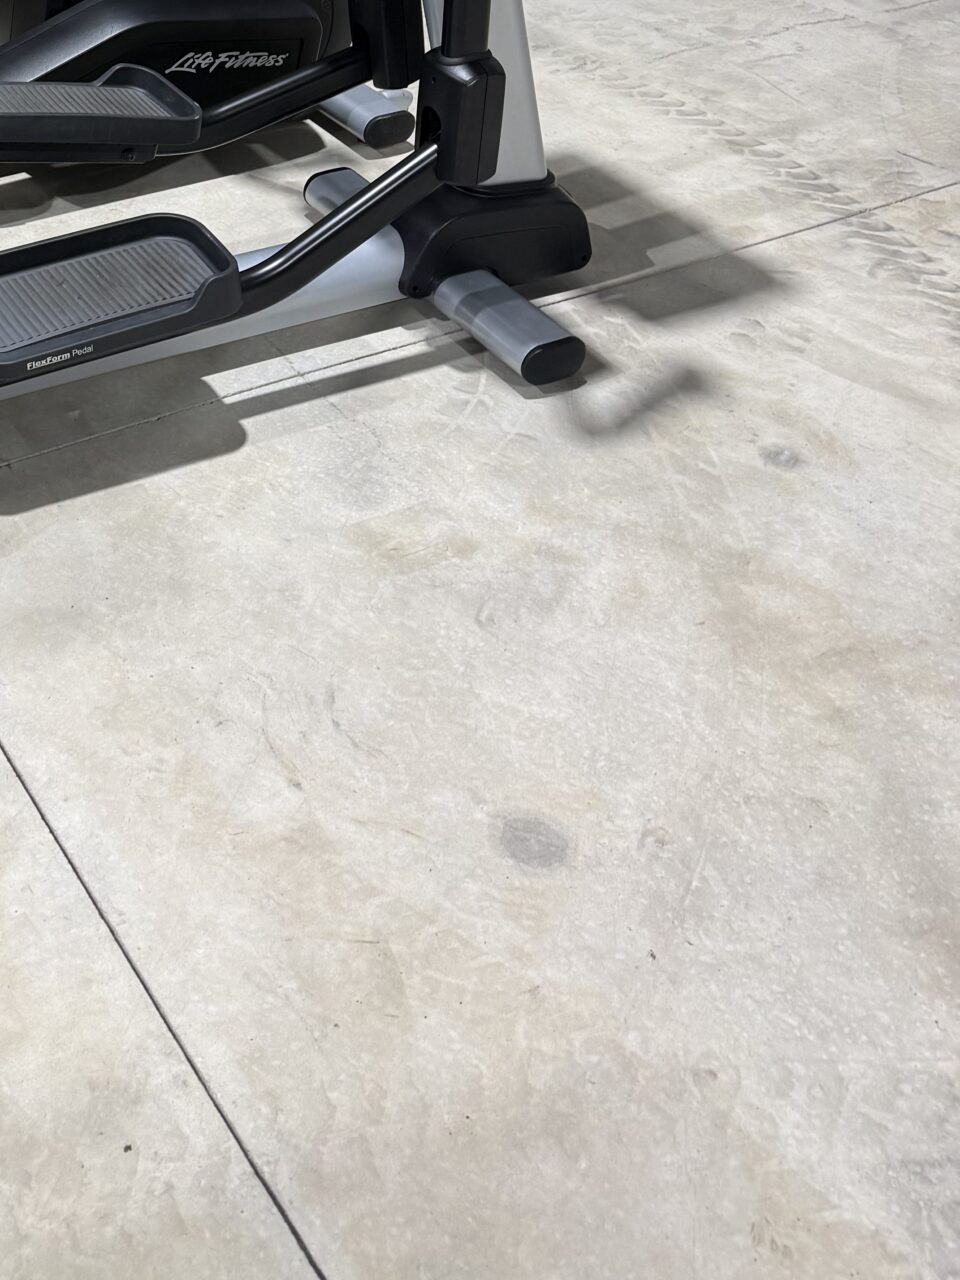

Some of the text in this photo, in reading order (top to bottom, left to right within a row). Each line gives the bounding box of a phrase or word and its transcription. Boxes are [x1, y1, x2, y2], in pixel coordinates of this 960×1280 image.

[165, 51, 286, 74] Life Fitness
[26, 344, 94, 370] FlexForm Pedal
